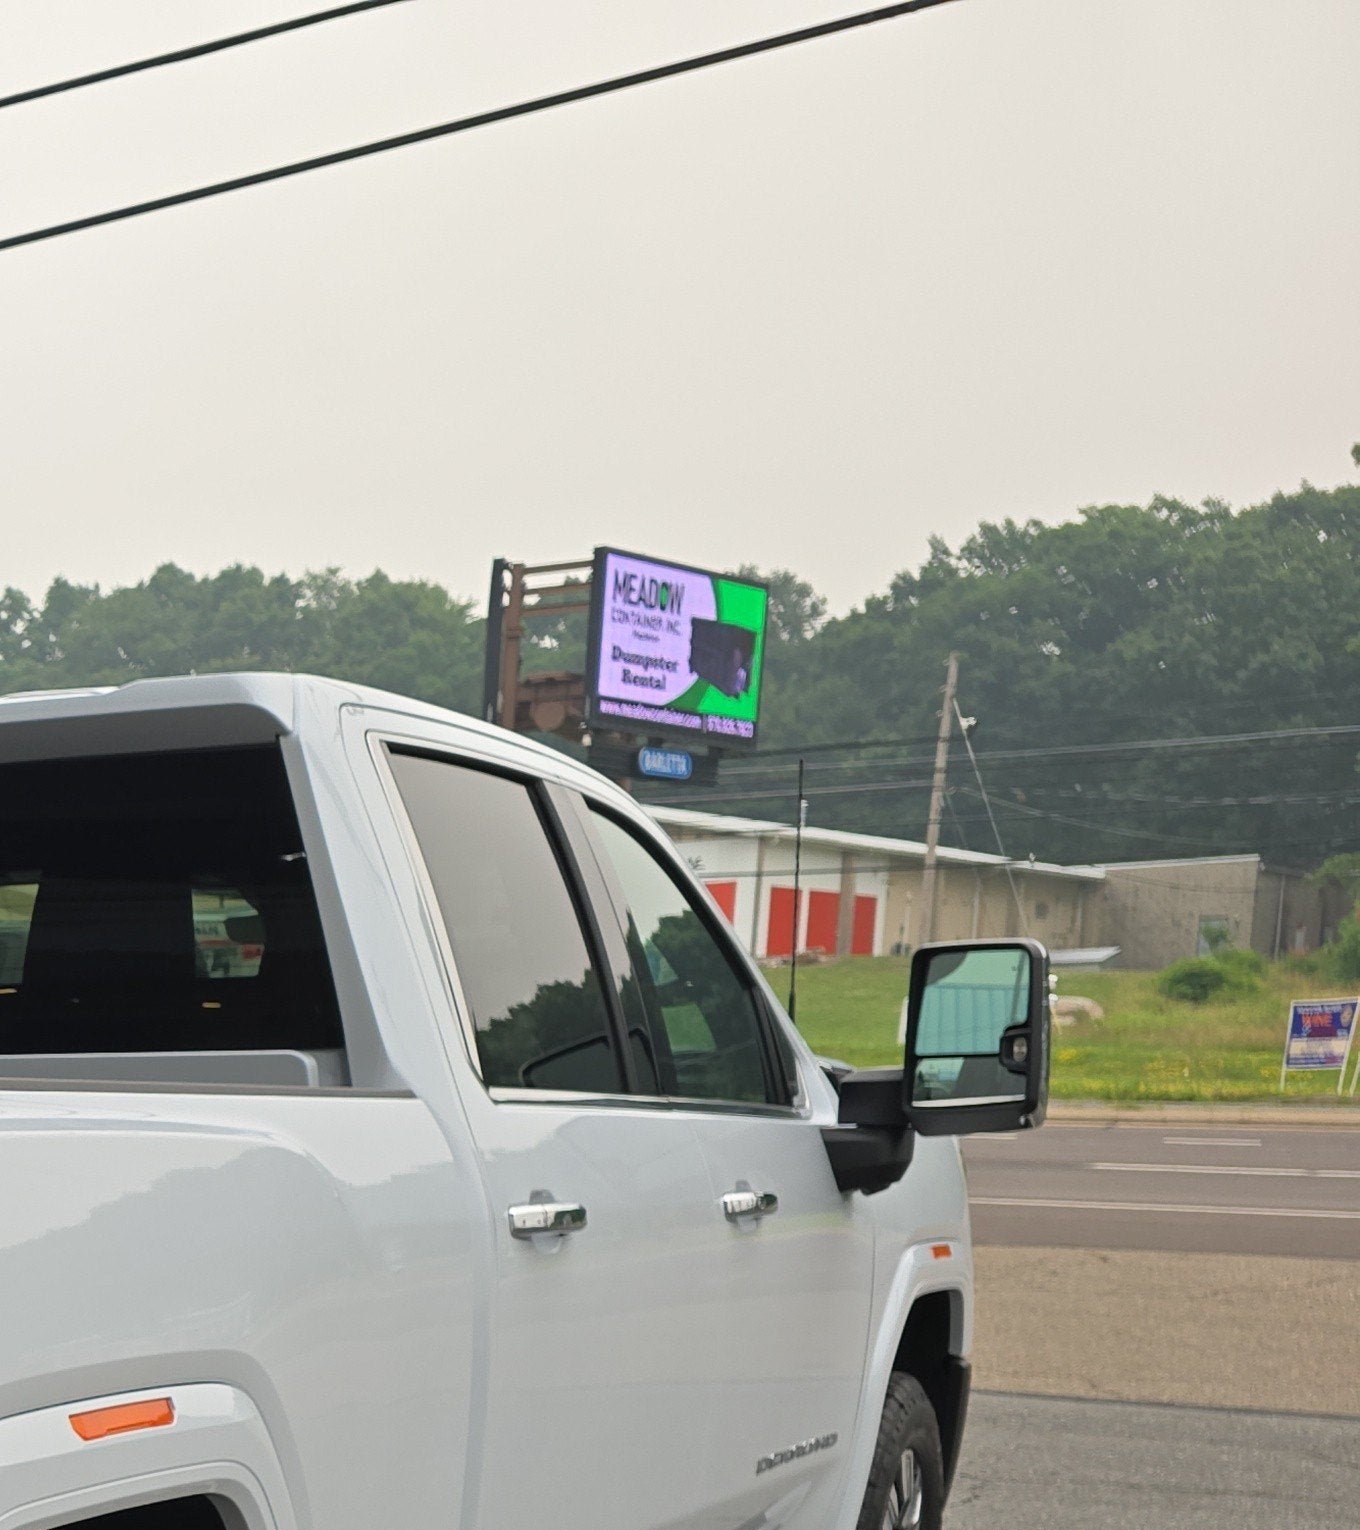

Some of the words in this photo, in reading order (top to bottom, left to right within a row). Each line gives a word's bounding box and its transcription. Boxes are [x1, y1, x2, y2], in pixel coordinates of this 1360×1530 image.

[612, 569, 685, 616] MEADOW
[610, 606, 663, 632] CONTAINER
[611, 643, 679, 674] Dumpster
[621, 668, 667, 691] Rental
